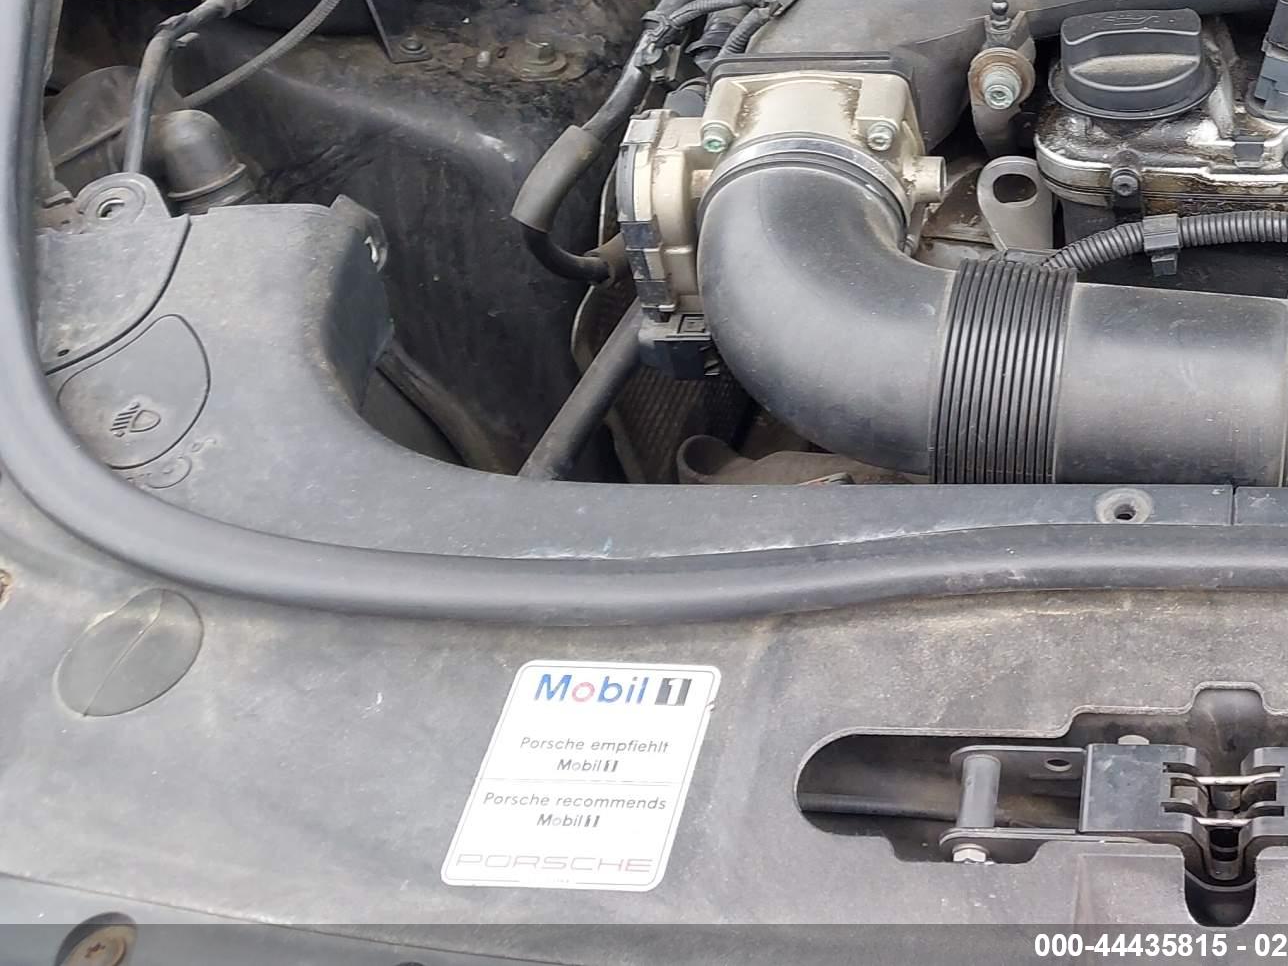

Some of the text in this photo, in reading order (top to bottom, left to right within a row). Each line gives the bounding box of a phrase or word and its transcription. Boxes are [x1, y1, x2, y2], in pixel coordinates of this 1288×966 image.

[534, 673, 650, 704] Mobil
[520, 737, 668, 754] Porsche empfiehlt
[556, 758, 602, 772] Mobil
[483, 792, 667, 809] Porsche recommends
[537, 813, 583, 827] Mobil
[455, 854, 654, 872] PORSCHE
